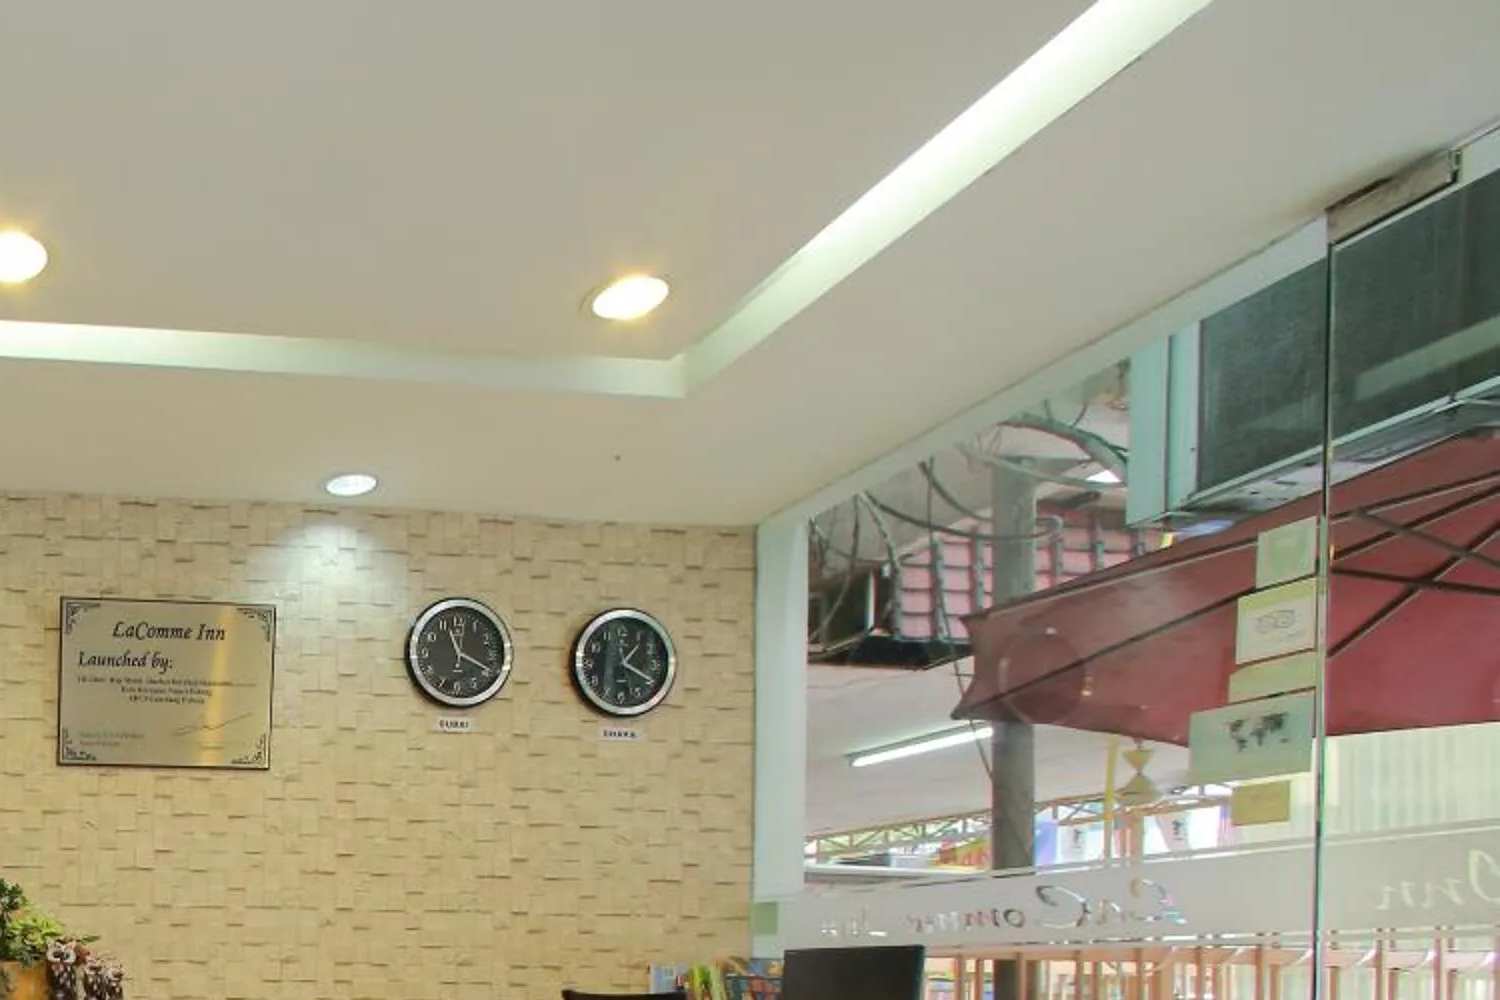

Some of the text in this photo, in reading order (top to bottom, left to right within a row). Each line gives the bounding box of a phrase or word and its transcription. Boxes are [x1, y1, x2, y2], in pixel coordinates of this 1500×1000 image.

[113, 620, 226, 641] LaComme Inn
[78, 650, 173, 674] Launched by:
